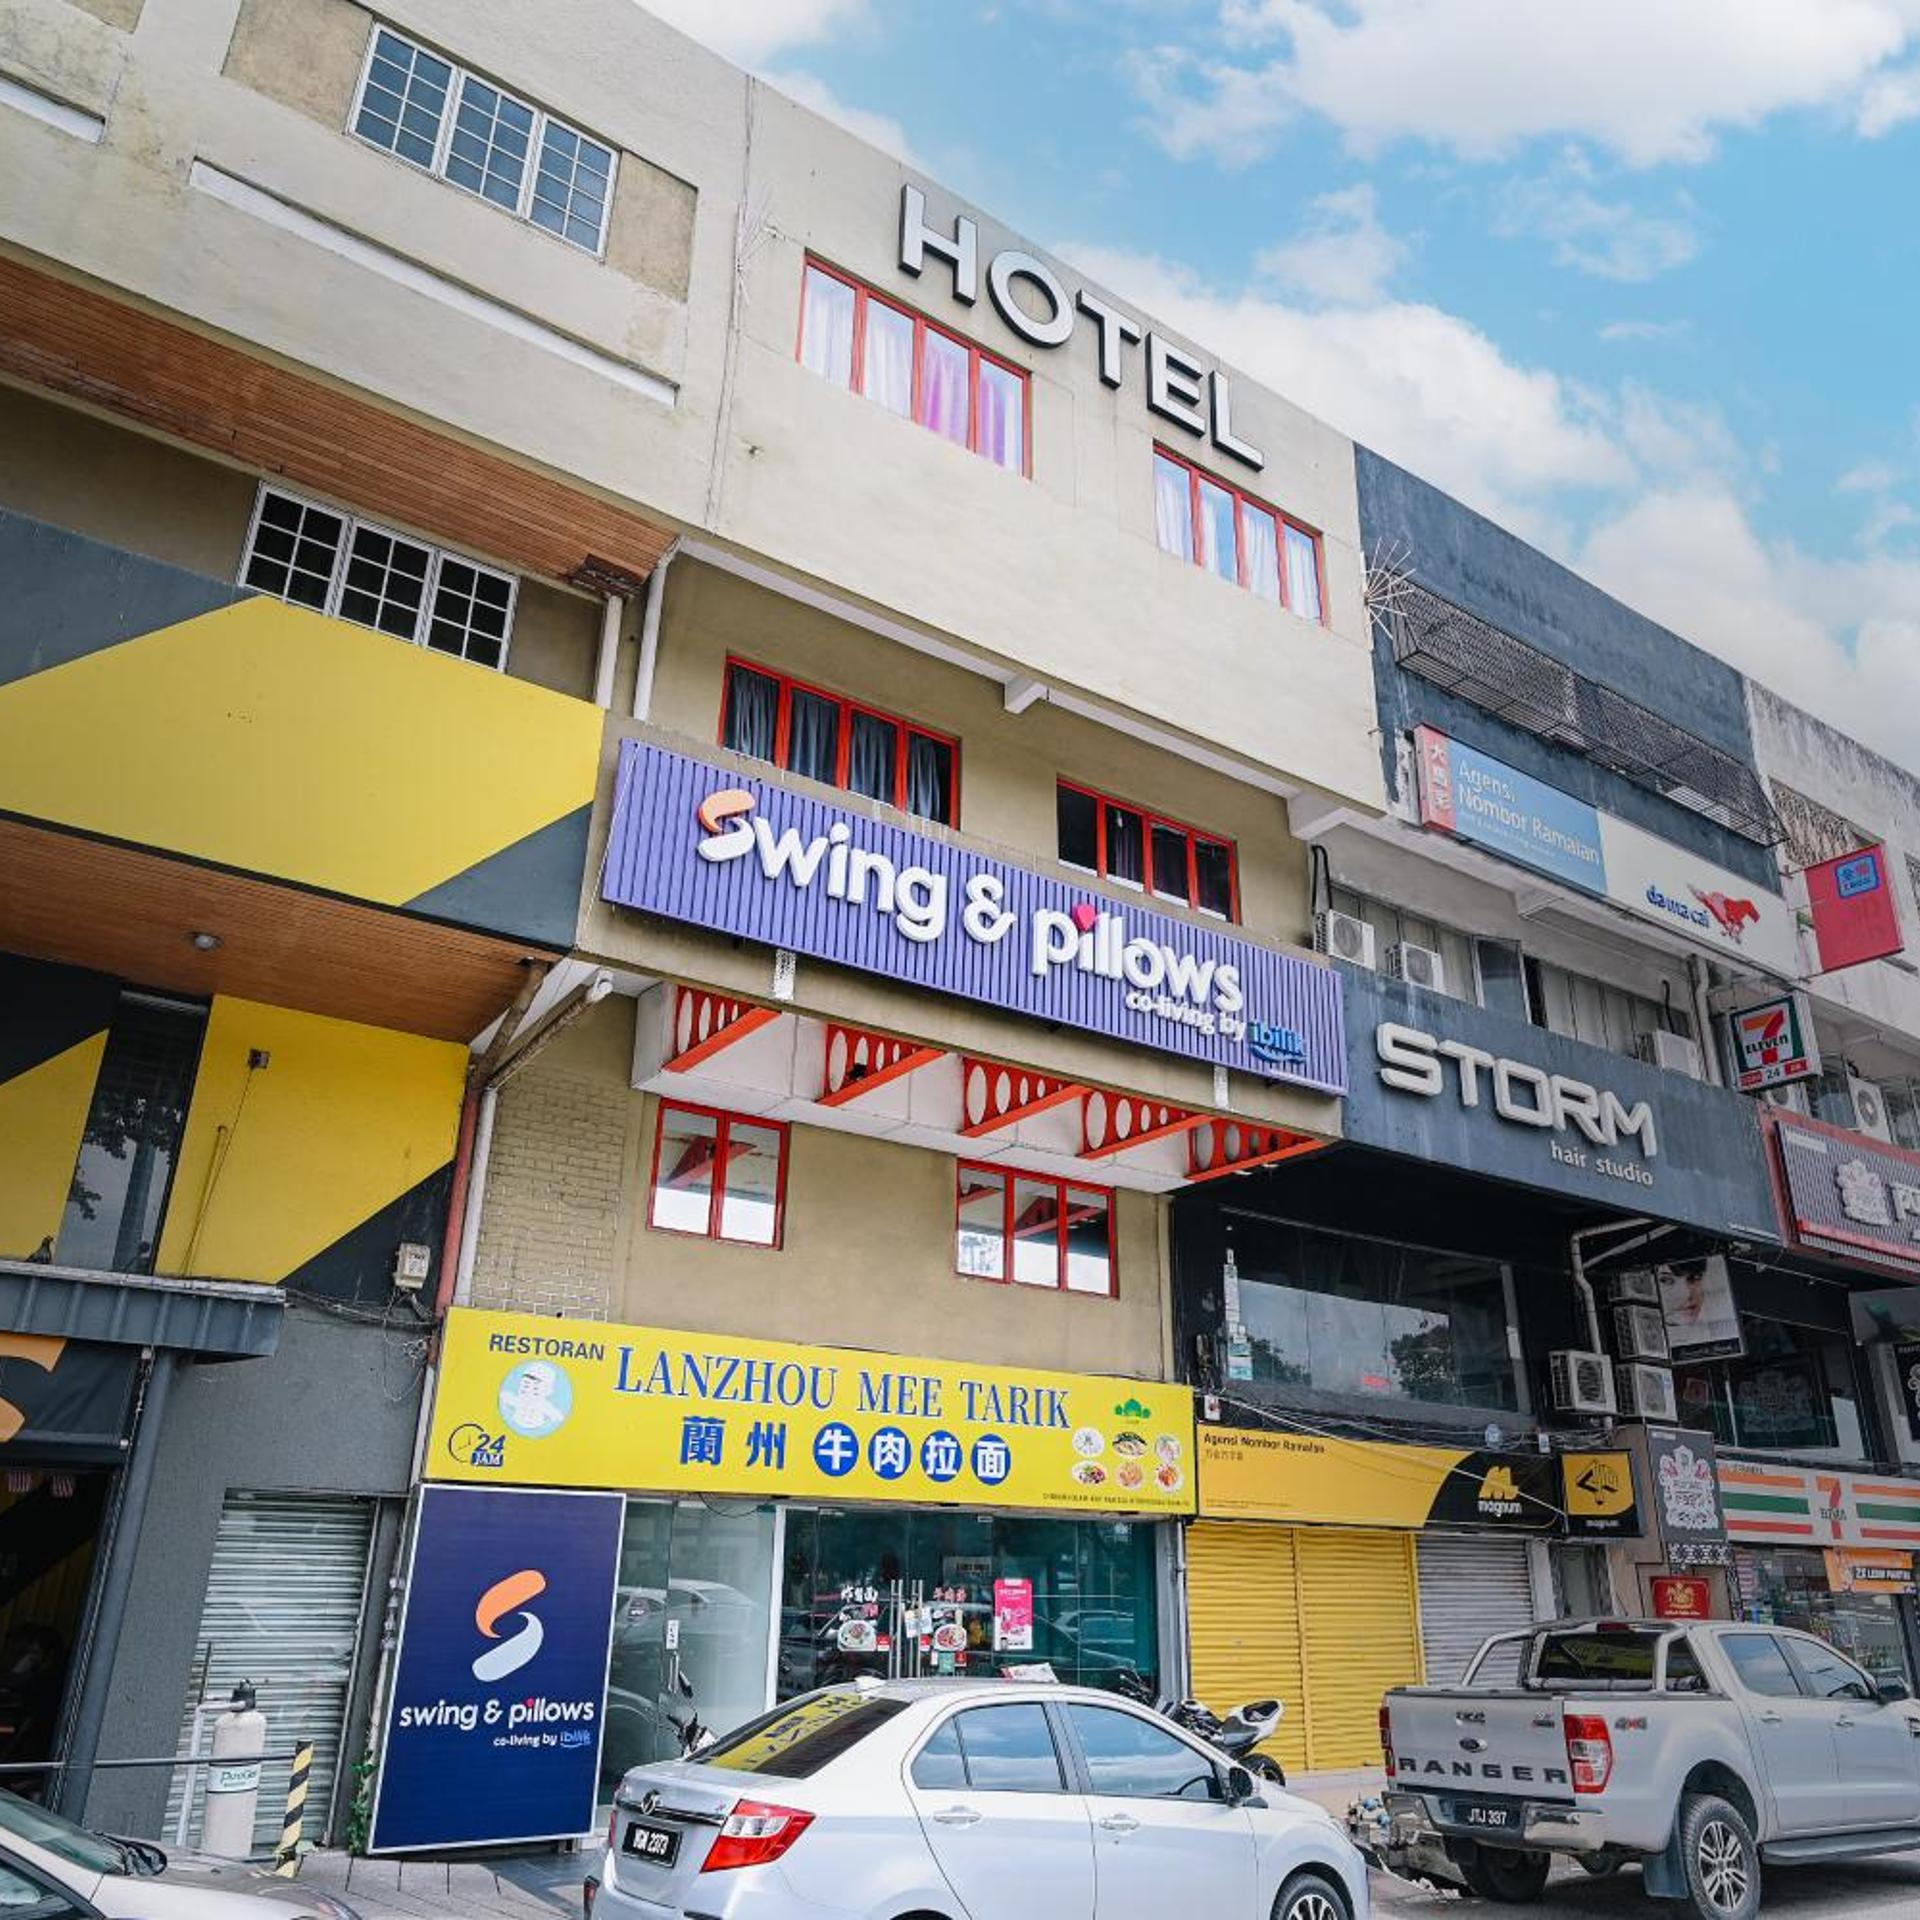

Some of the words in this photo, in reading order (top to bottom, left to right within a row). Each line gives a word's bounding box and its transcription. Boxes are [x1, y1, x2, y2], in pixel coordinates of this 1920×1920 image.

[898, 183, 1264, 472] HOTEL
[964, 874, 1016, 943] &
[1032, 903, 1244, 1012] pillows
[1218, 1011, 1246, 1042] by
[1376, 1021, 1657, 1157] STORM
[1551, 1140, 1586, 1167] hair
[1596, 1157, 1654, 1186] studio
[489, 1333, 605, 1361] RESTORAN
[613, 1346, 837, 1410] LANZHOU
[856, 1371, 942, 1418] MEE
[960, 1380, 1071, 1429] TARIK
[474, 1433, 505, 1453] 24
[1203, 1432, 1238, 1446] Agensi
[472, 1451, 503, 1467] JAM
[399, 1700, 478, 1731] swing
[483, 1699, 502, 1724] &
[508, 1697, 594, 1729] pillows
[493, 1734, 540, 1748] co-living
[542, 1732, 558, 1747] by
[1398, 1756, 1569, 1785] RANGER
